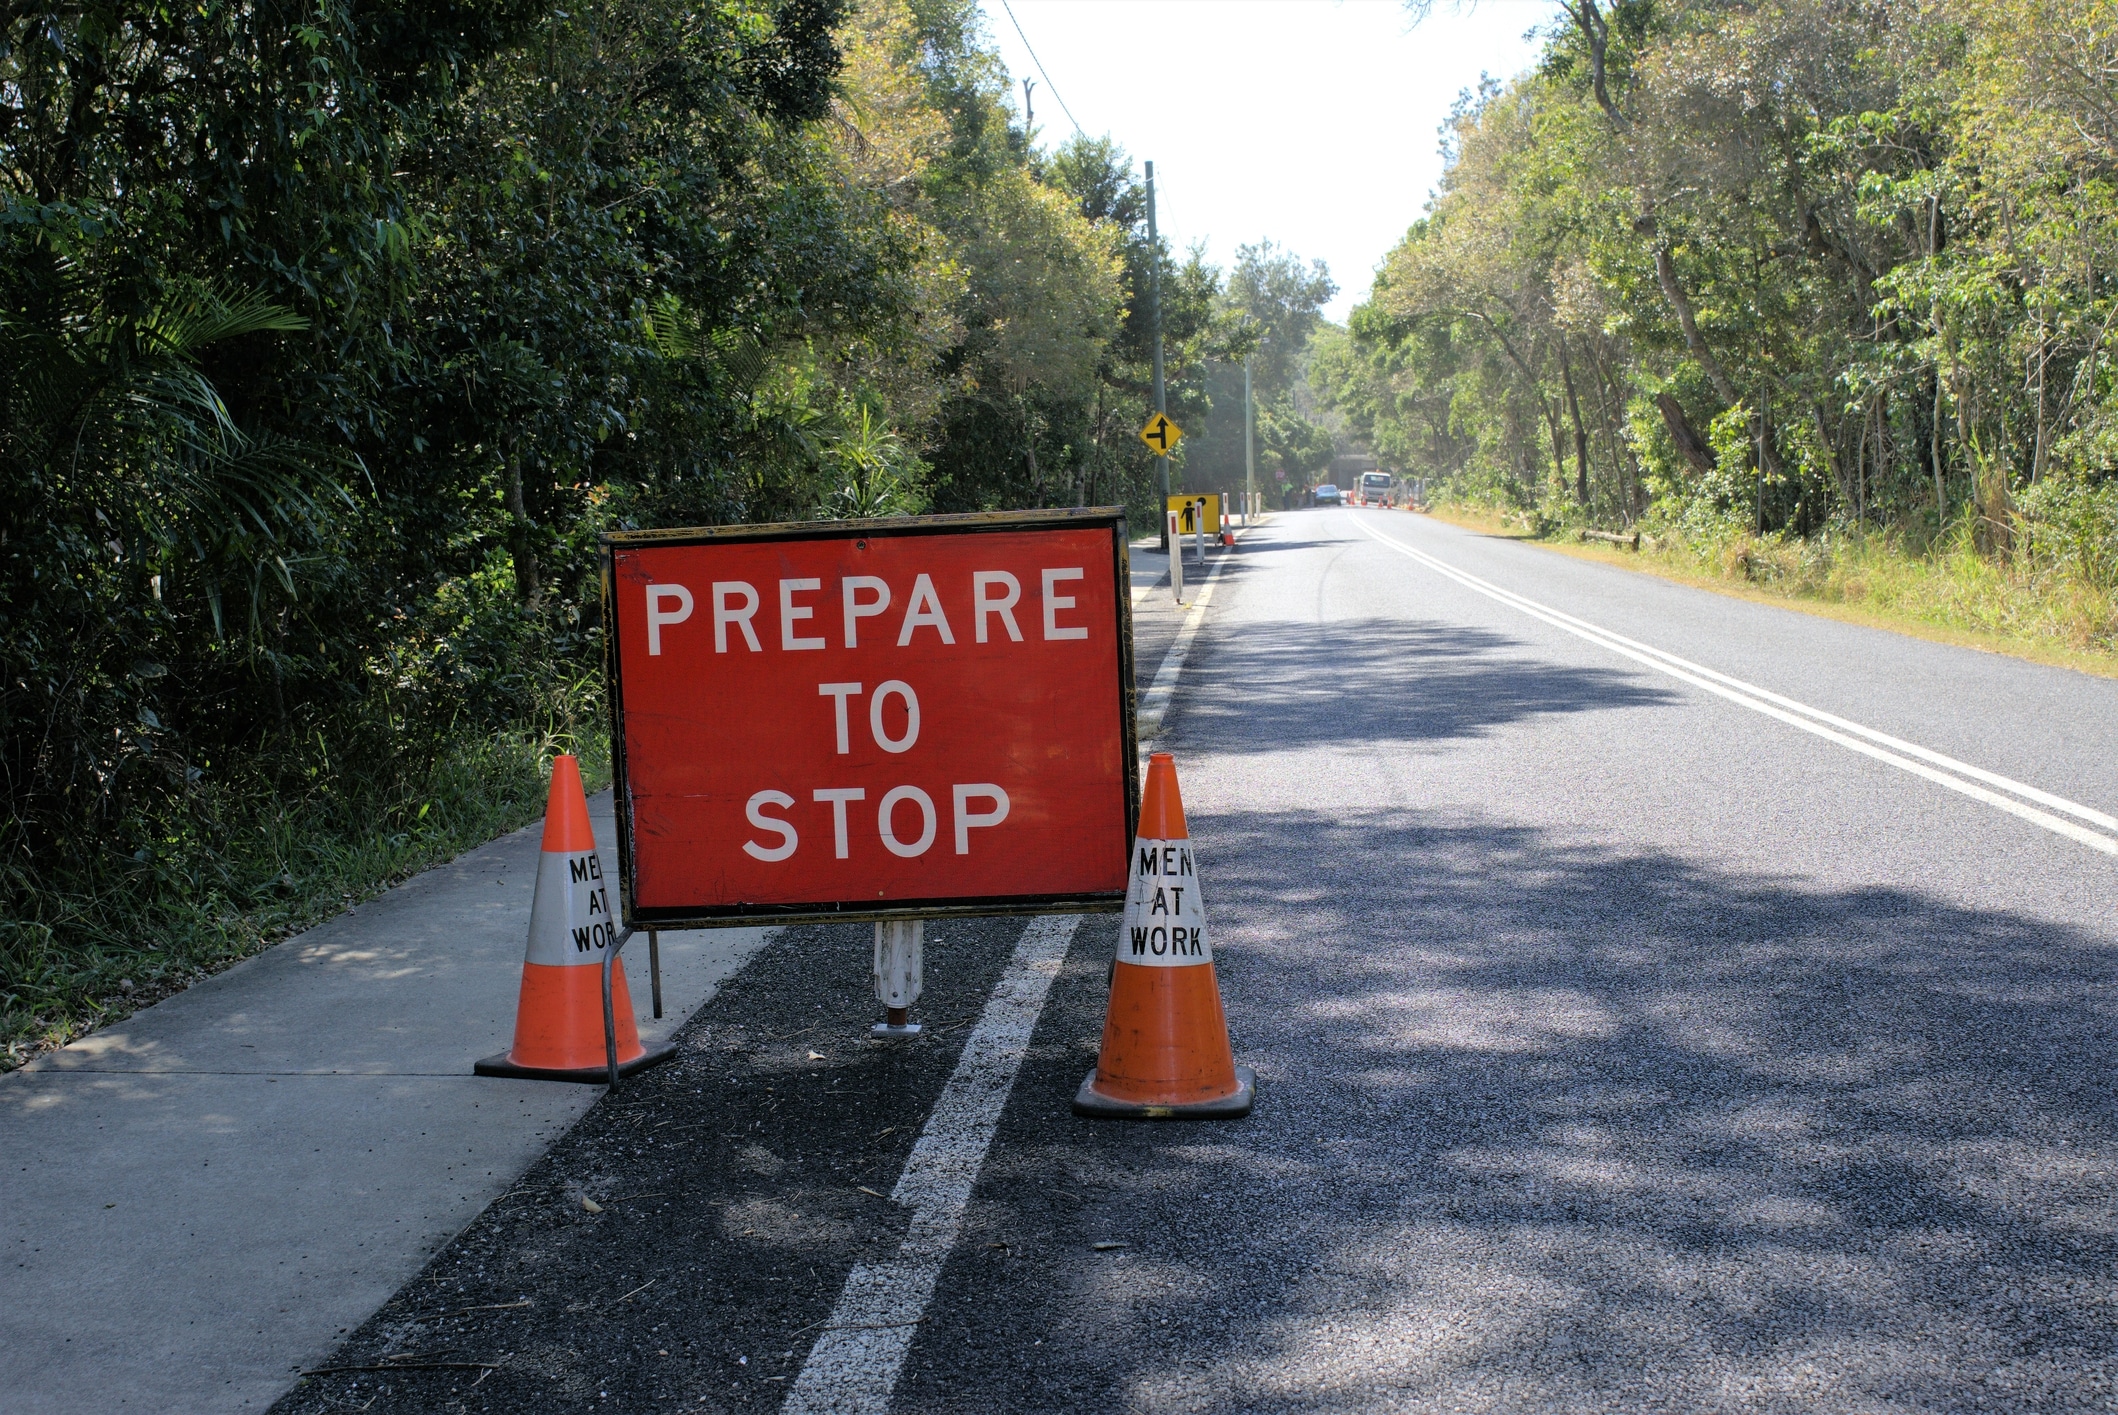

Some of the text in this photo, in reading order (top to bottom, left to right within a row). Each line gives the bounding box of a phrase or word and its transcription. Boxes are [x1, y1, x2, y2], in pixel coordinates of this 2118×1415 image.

[645, 567, 1089, 656] PREPARE
[818, 679, 921, 755] TO
[742, 783, 1010, 862] STOP
[569, 854, 602, 883] ME
[1139, 847, 1193, 876] MEN
[590, 888, 607, 915] AT
[1151, 887, 1184, 916] AT
[571, 922, 616, 952] WOR
[1130, 927, 1203, 956] WORK
